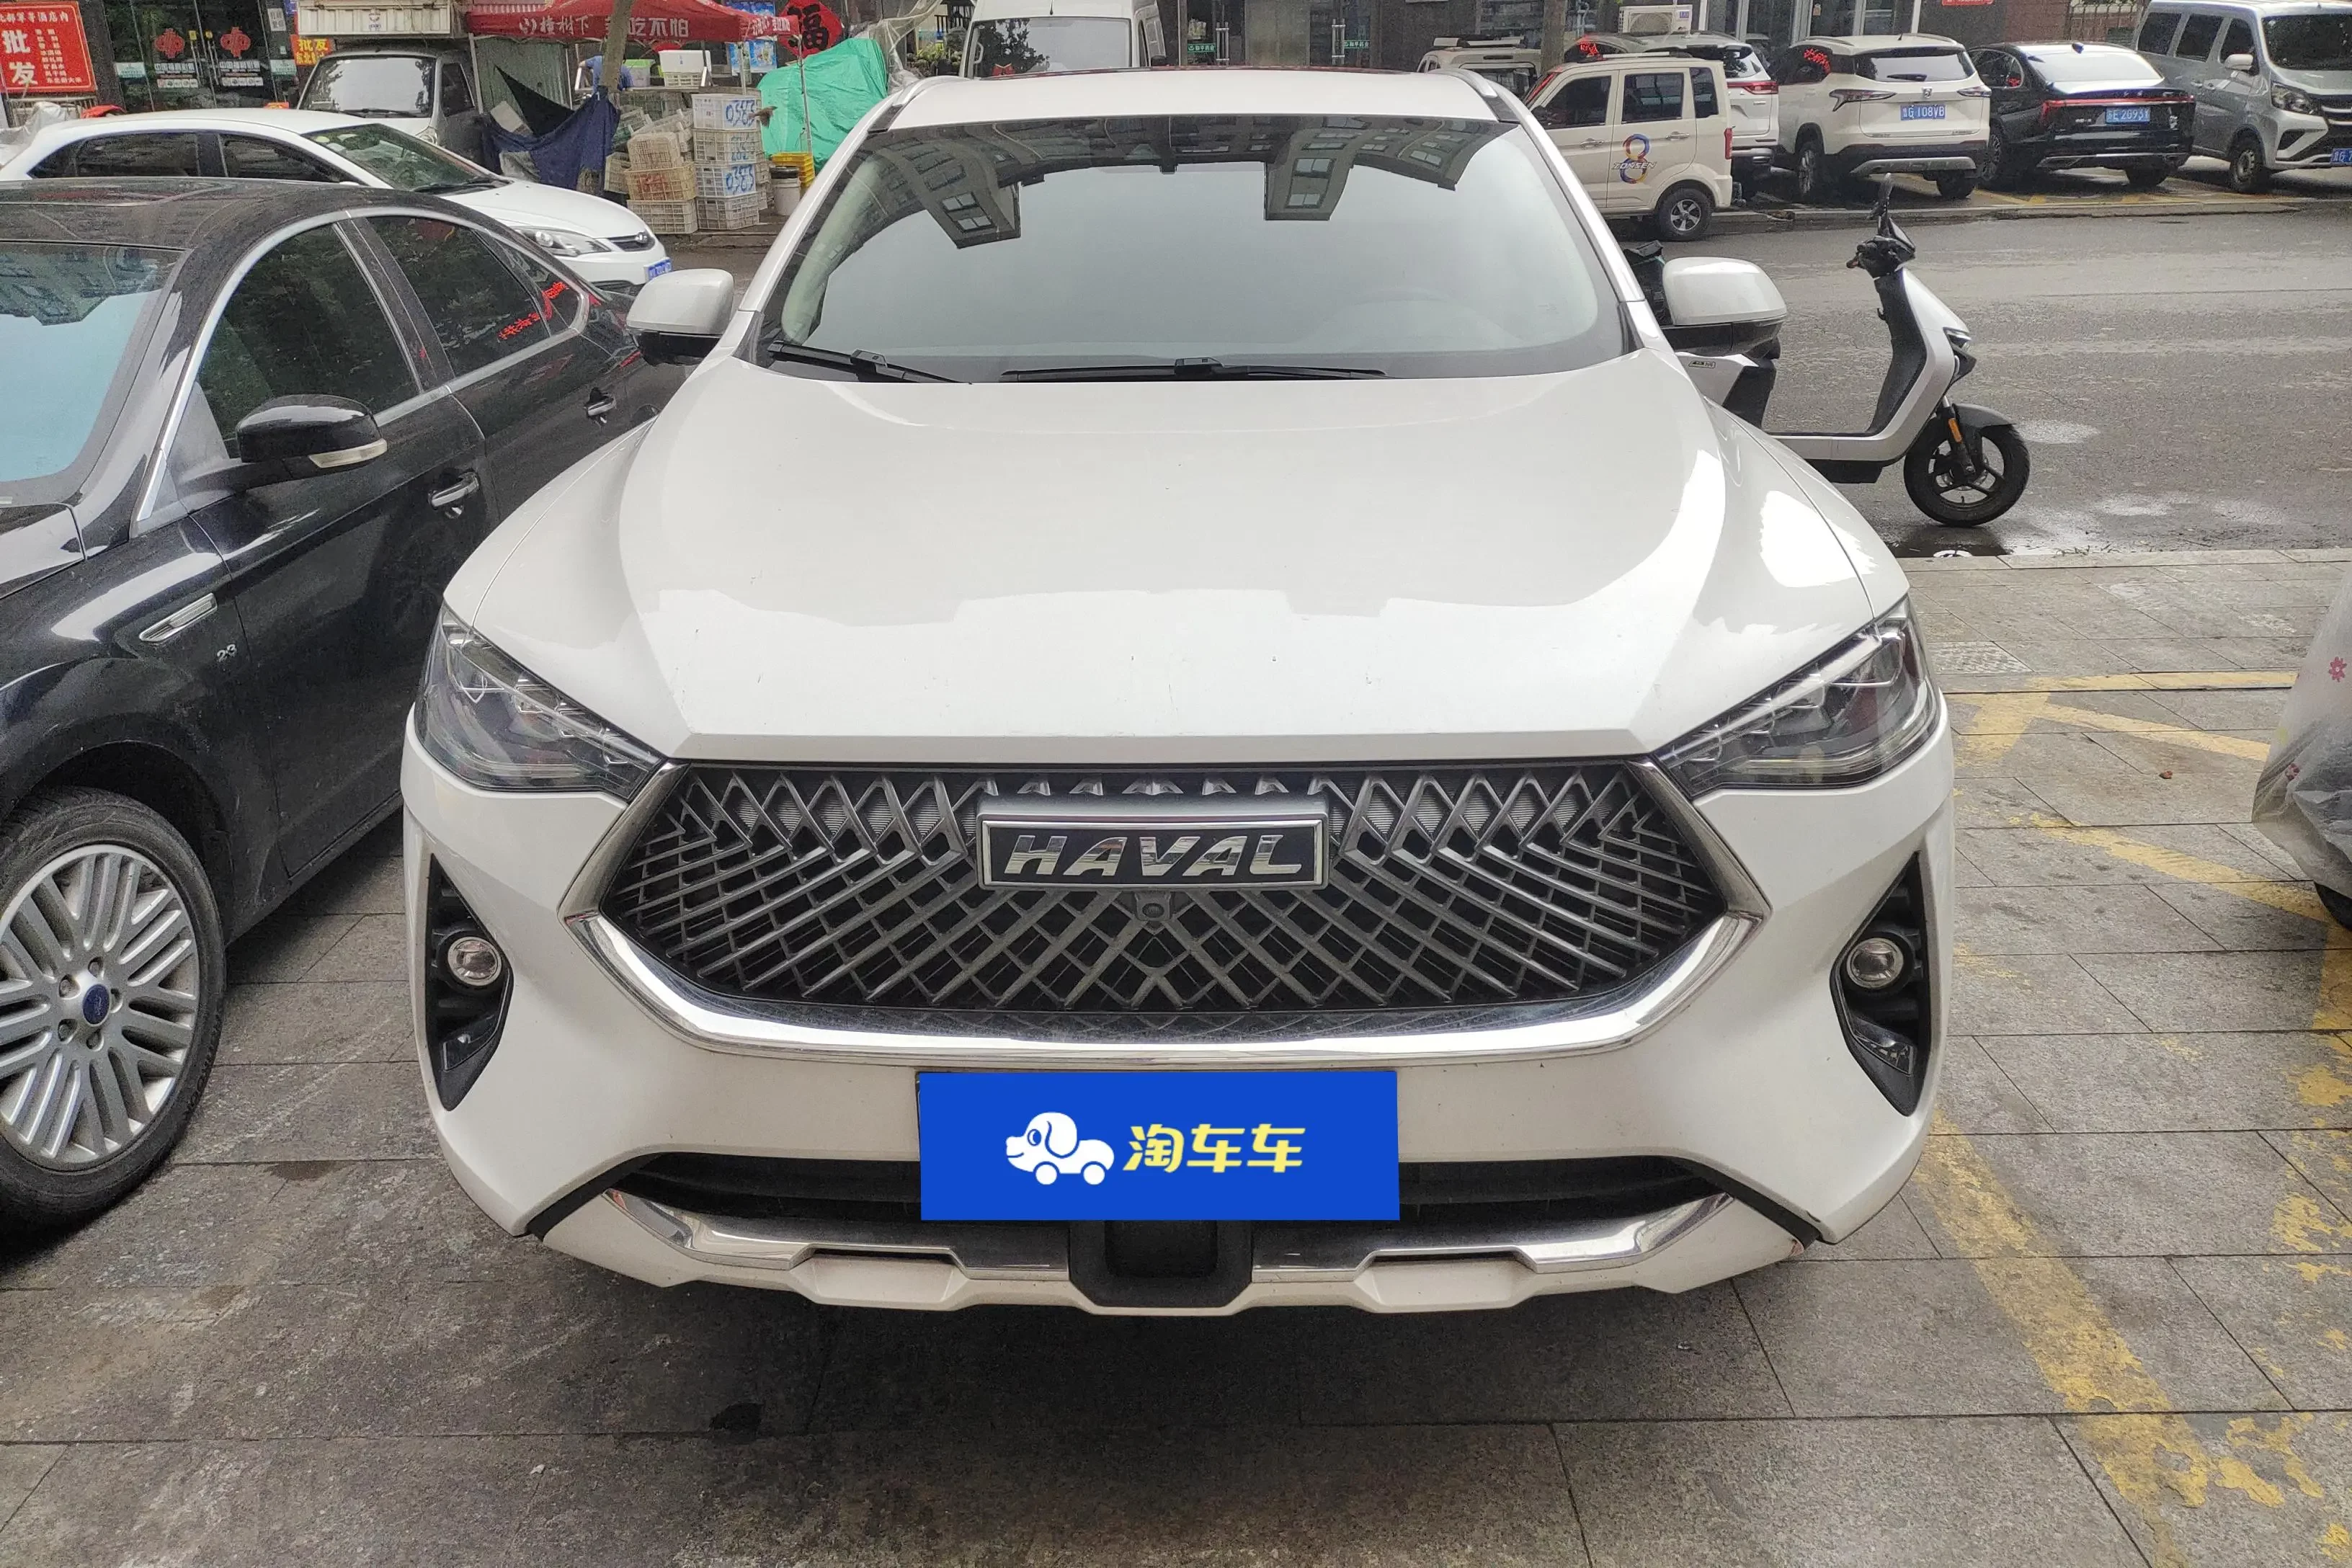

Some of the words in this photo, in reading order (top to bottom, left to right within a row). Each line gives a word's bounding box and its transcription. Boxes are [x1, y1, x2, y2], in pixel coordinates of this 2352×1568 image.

[786, 3, 829, 50] 福
[1, 29, 38, 84] 批发
[1004, 834, 1301, 877] HAVAL
